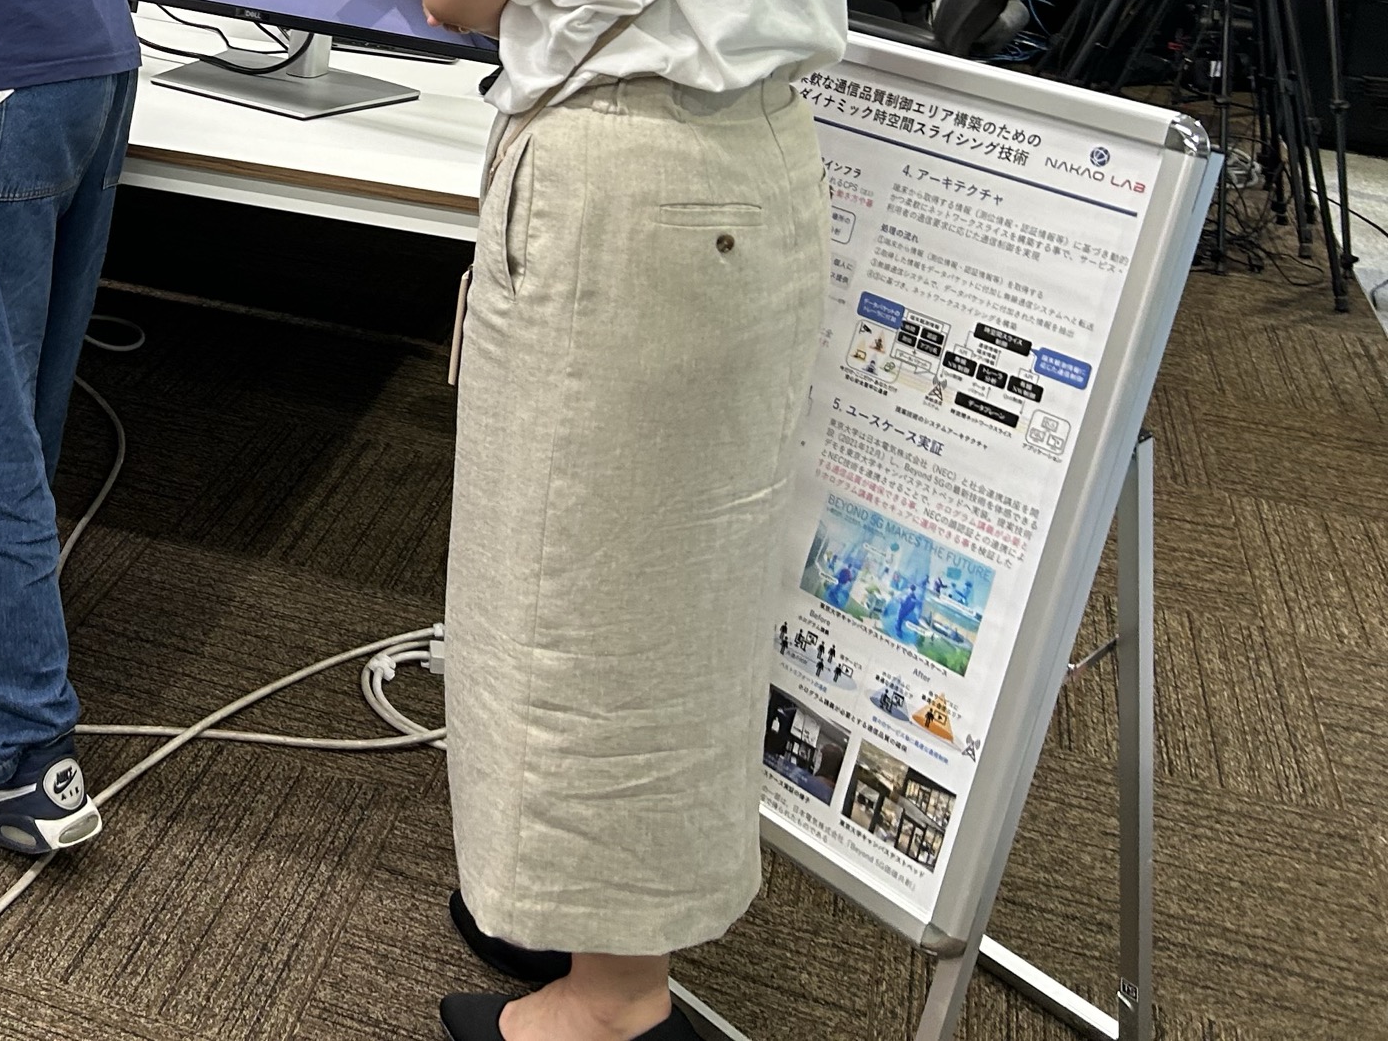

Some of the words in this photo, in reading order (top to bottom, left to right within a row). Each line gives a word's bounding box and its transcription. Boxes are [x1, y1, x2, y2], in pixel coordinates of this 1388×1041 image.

[244, 9, 262, 19] DELL
[800, 69, 1043, 148] 軟な通信品質制御エリア構築のための
[797, 87, 1030, 166] ダイナミック時空間スライシング技術
[915, 167, 1005, 206] アーキテクチャ
[1044, 156, 1105, 182] NAKAO
[1109, 174, 1147, 194] LAB
[880, 222, 920, 243] 処理の流れ
[831, 396, 844, 412] 5.
[844, 403, 945, 456] ユースケース実証
[826, 493, 869, 521] BEYOND
[868, 513, 884, 529] 5G
[884, 520, 922, 547] MAKES
[922, 539, 945, 558] THE
[944, 550, 993, 583] FUTURE
[809, 608, 831, 626] Before
[911, 667, 931, 684] After
[56, 765, 73, 786] NIKE
[61, 786, 79, 801] AIR
